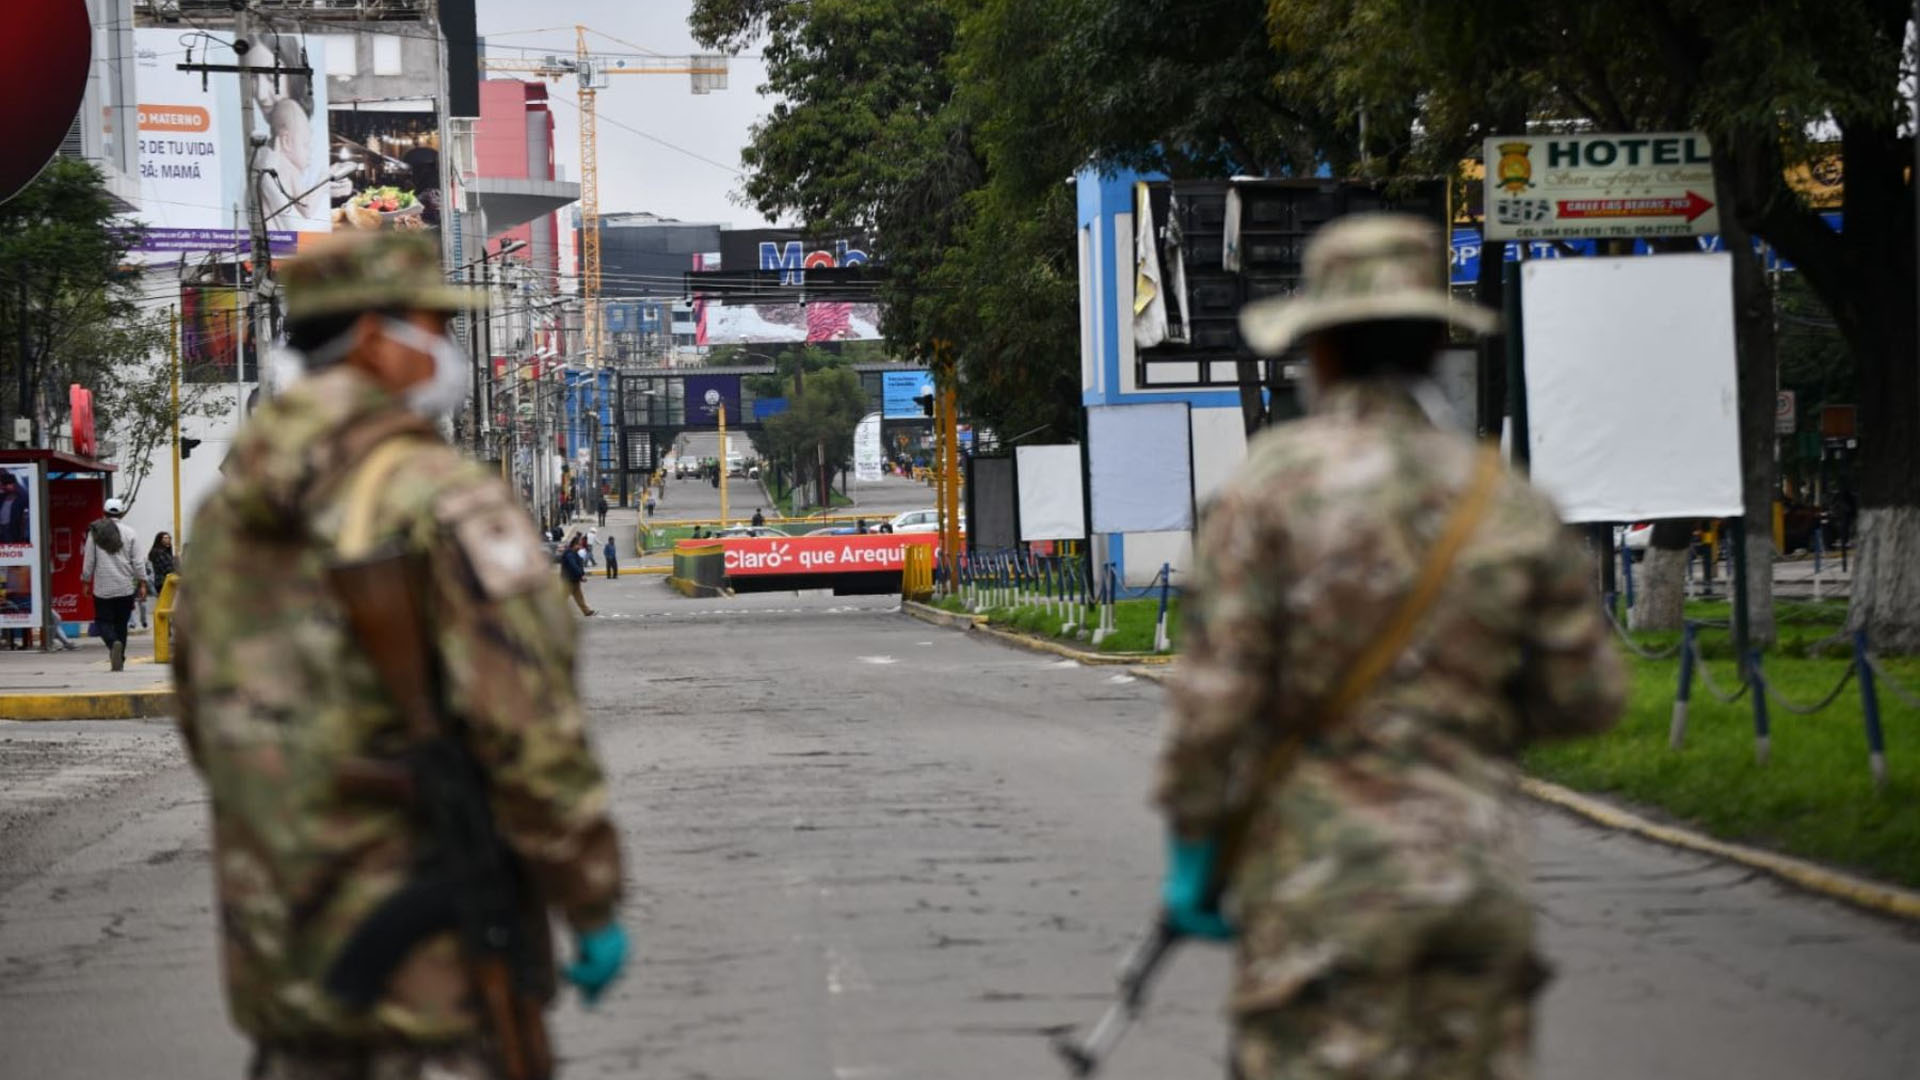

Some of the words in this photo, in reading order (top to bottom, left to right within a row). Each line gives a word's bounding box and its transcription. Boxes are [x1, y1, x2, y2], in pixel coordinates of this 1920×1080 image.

[149, 113, 202, 126] MATERNO
[149, 141, 165, 154] DE
[167, 141, 183, 155] TU
[186, 142, 215, 156] VIDA
[1548, 138, 1711, 167] HOTEL
[161, 161, 201, 179] MAMÁ
[723, 548, 783, 568] Claro
[800, 552, 835, 568] que
